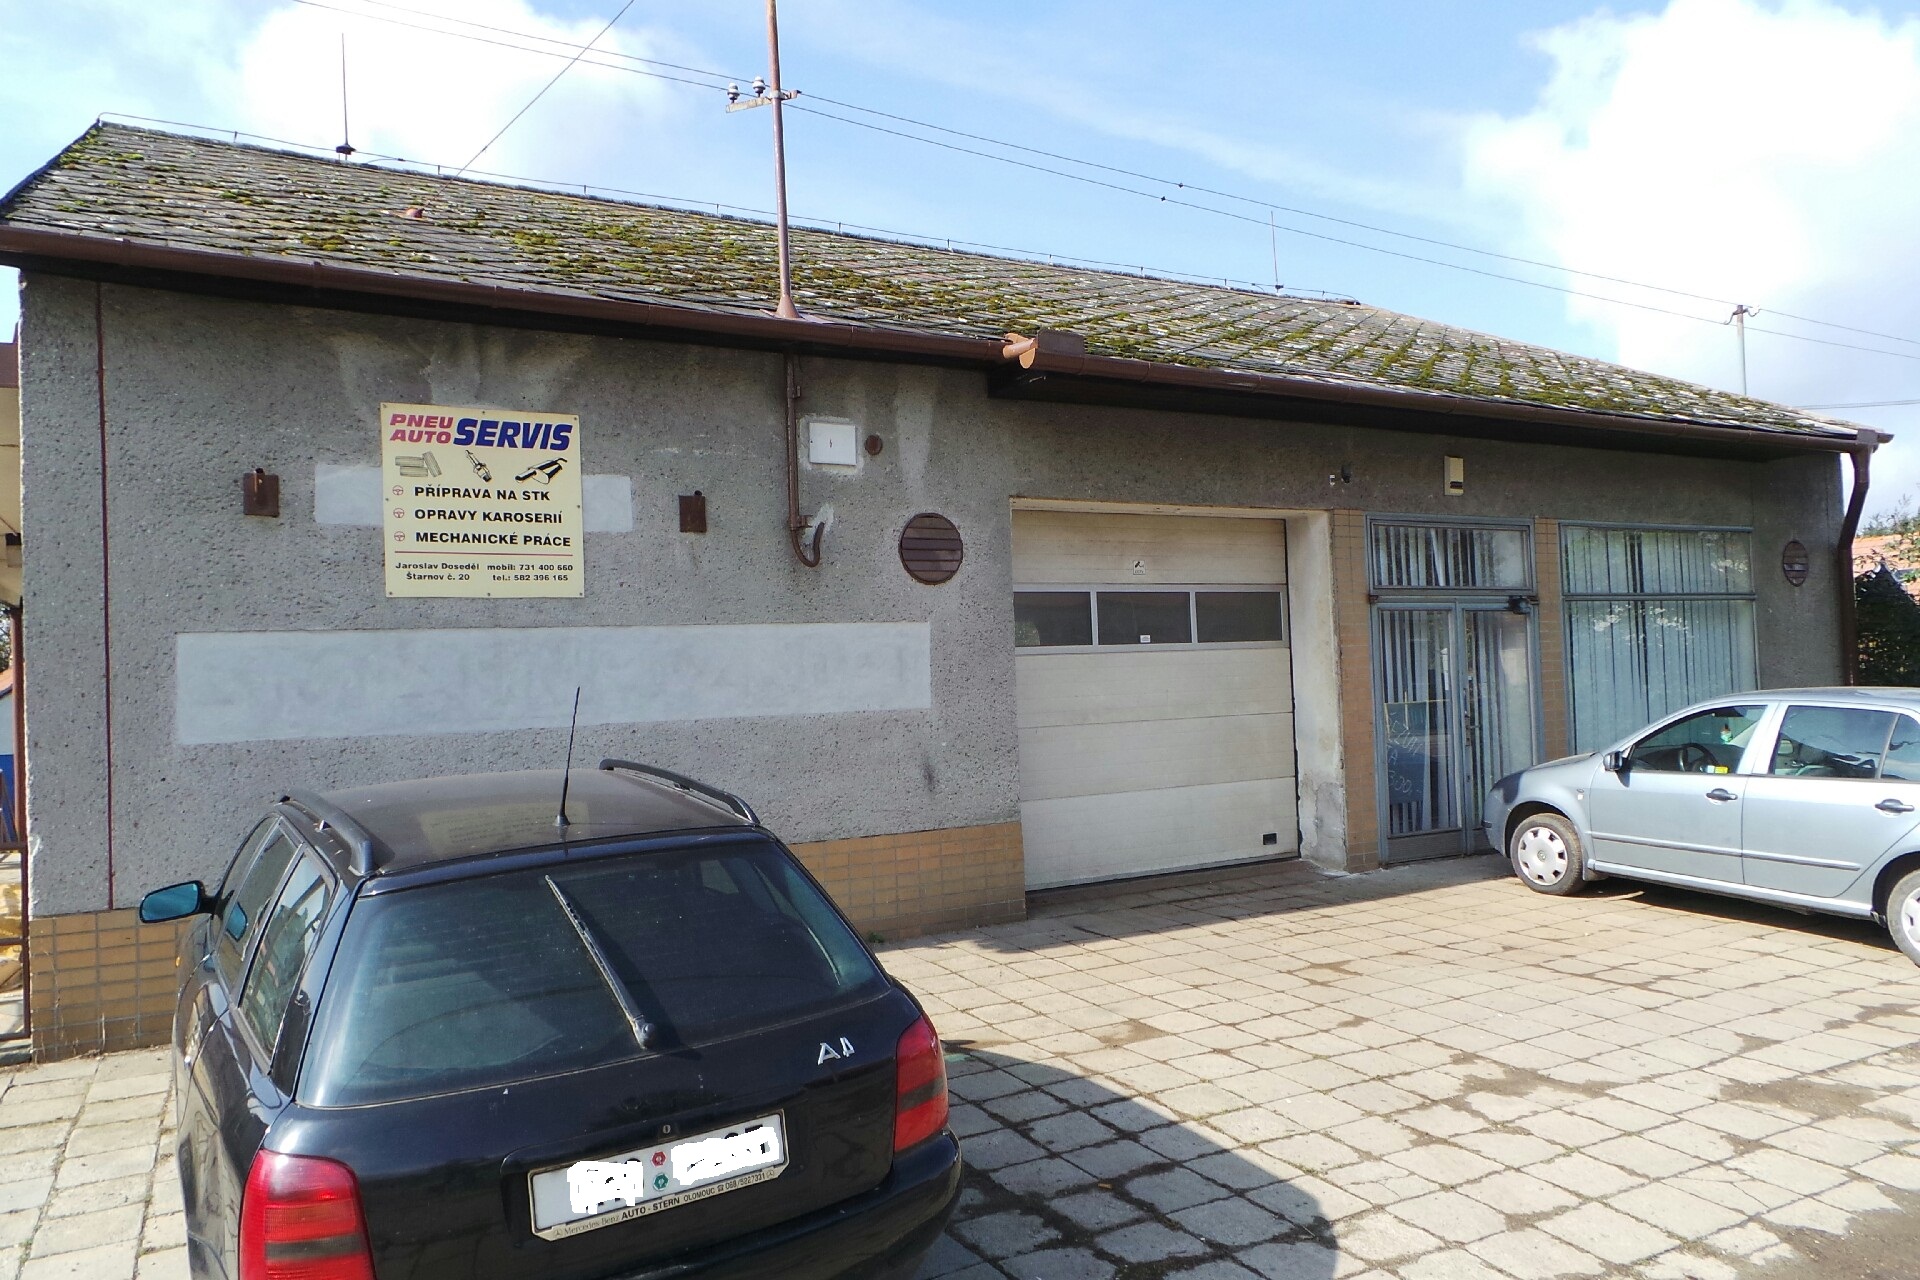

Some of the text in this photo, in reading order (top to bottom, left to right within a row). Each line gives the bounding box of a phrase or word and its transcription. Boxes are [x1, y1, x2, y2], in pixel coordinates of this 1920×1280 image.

[390, 413, 453, 429] PNEU
[390, 429, 451, 444] AUTO
[453, 418, 573, 451] SERVIS
[414, 484, 550, 501] PŘÍPRAVA NA STK
[414, 509, 562, 524] OPRAVY KAROSERIÍ
[415, 532, 571, 547] MECHANICKÉ PRÁCE
[395, 562, 479, 571] Jaroslav Doseděl
[406, 571, 444, 581] Štarnov
[458, 573, 470, 581] 20
[817, 1037, 855, 1066] A4
[621, 1206, 646, 1220] AUTO
[652, 1197, 680, 1211] STERN
[683, 1187, 716, 1202] OLOMOUC
